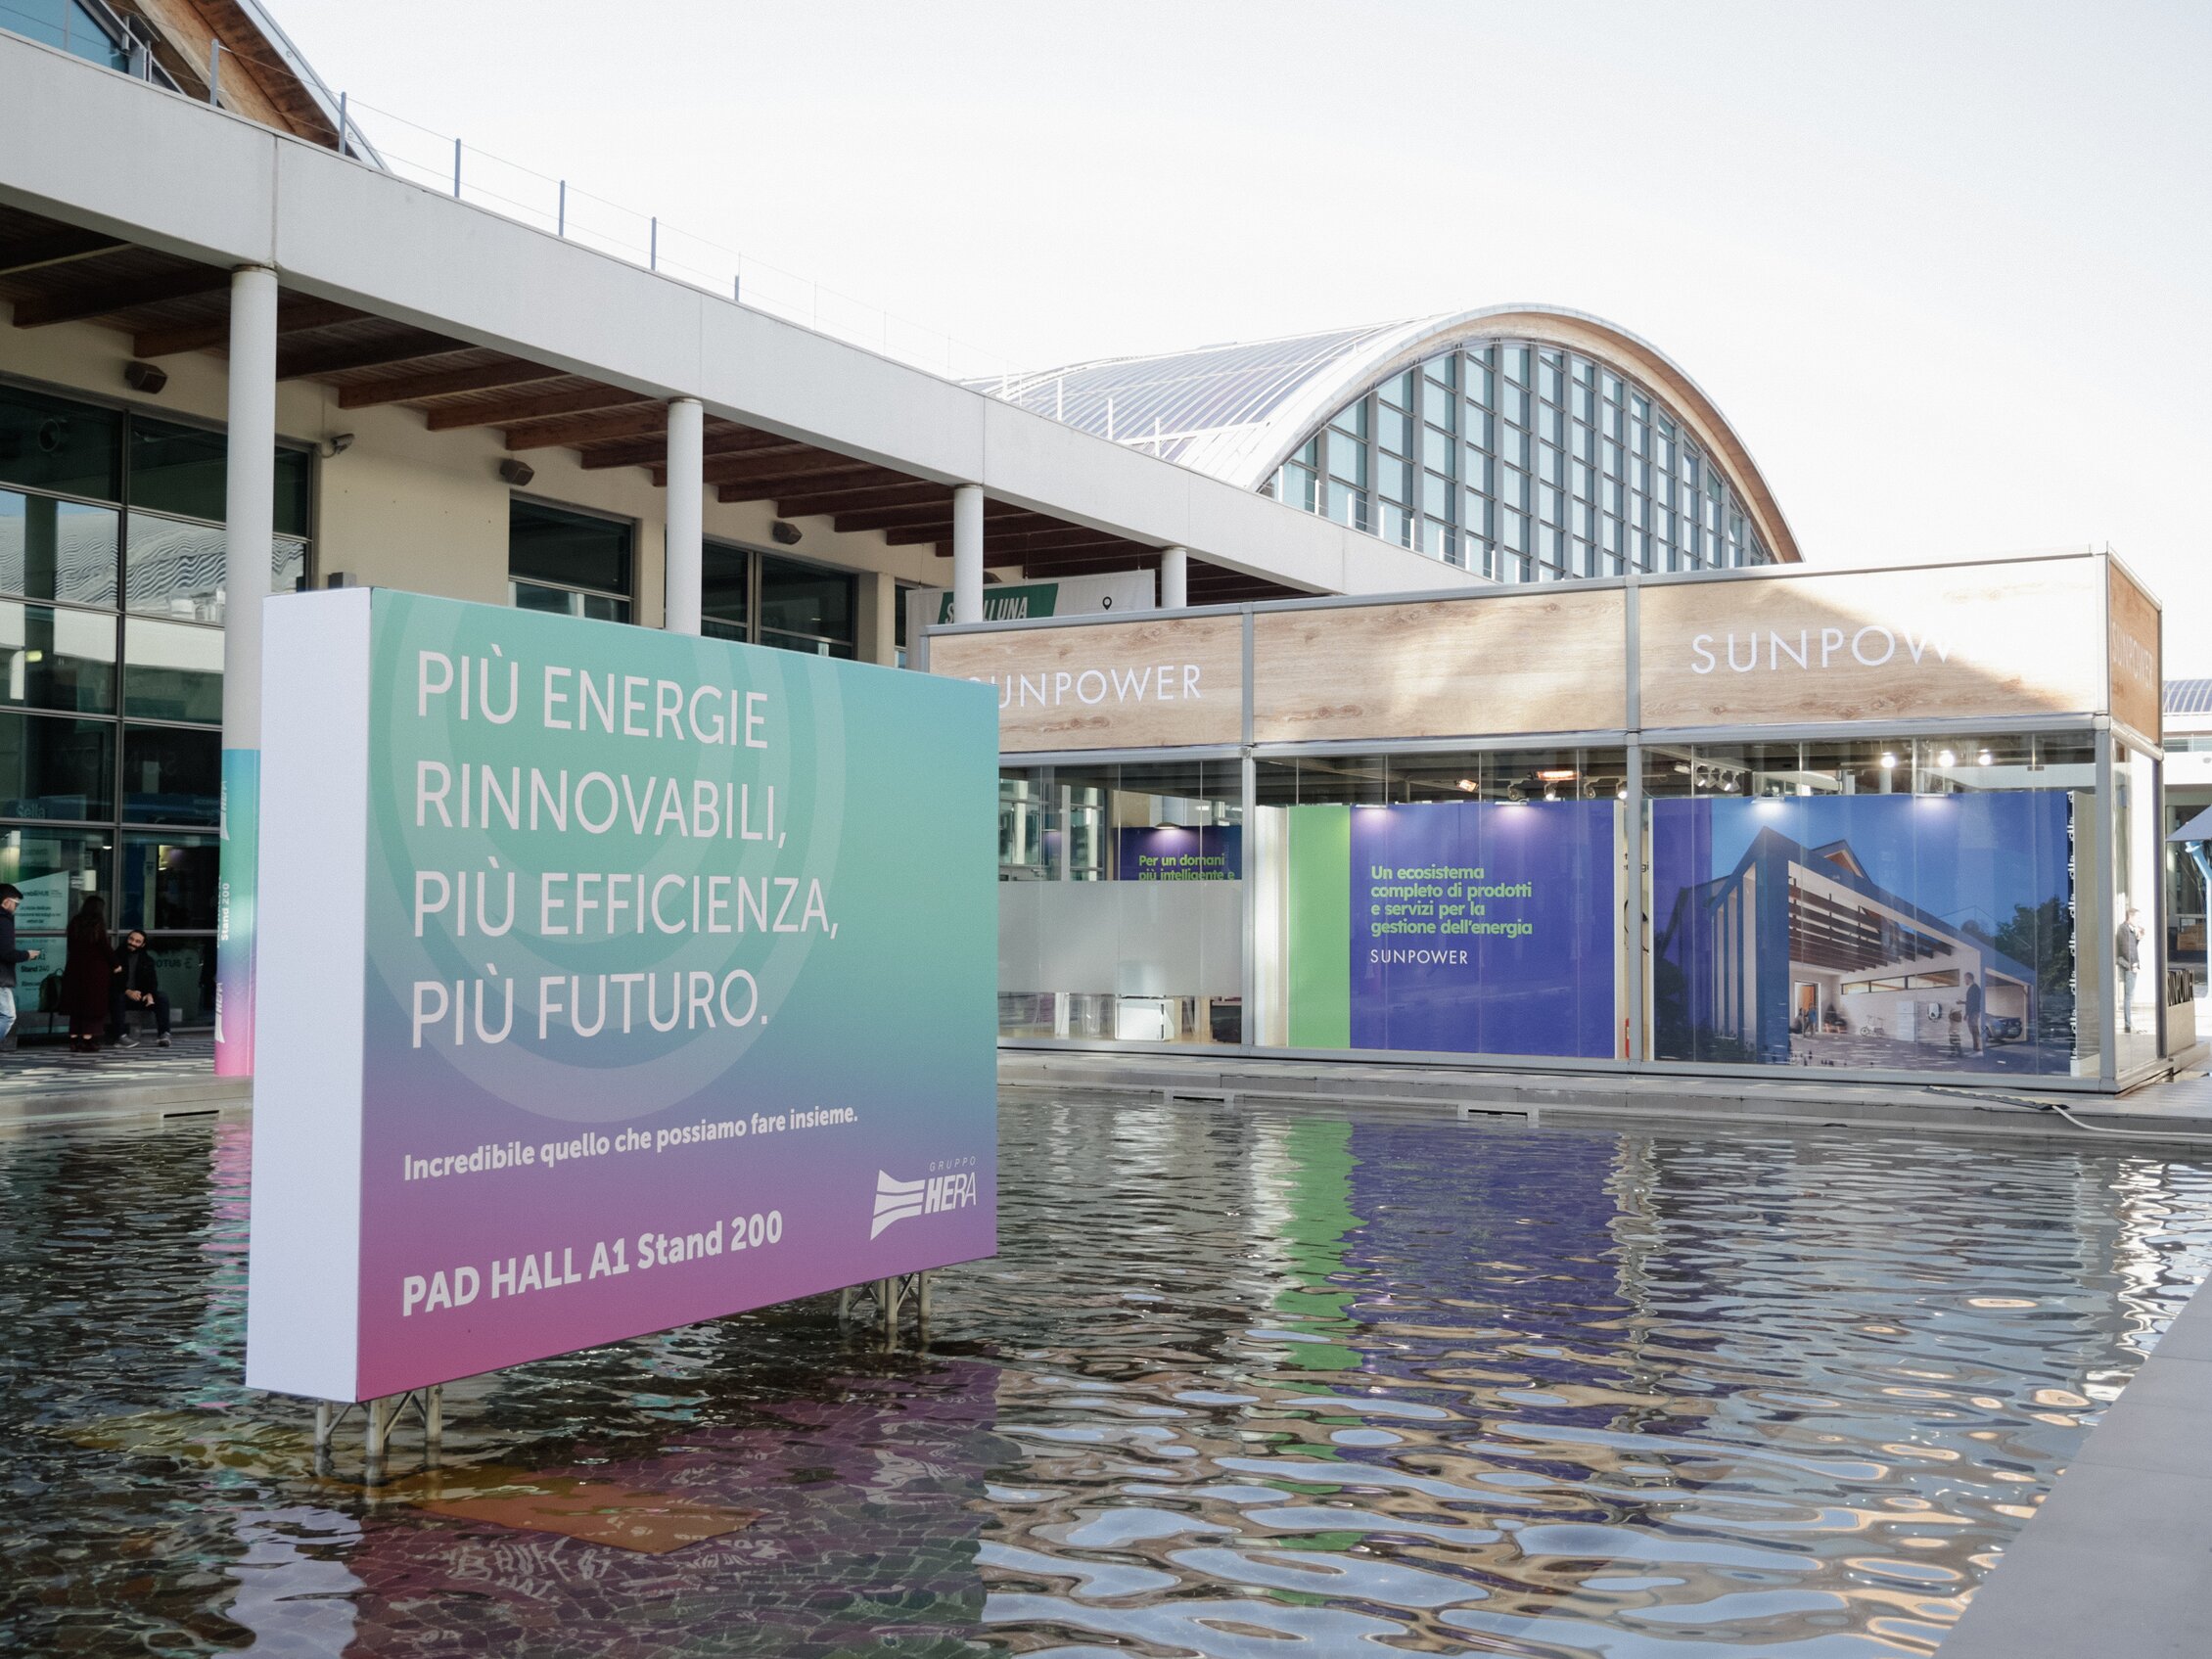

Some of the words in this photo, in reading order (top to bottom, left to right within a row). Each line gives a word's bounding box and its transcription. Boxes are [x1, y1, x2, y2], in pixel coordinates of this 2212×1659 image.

[996, 597, 1028, 621] UNA
[418, 643, 519, 725] PIÙ
[543, 665, 768, 749] ENERGIE
[969, 665, 1202, 709] UNPOWER
[416, 760, 786, 849] RINNOVABILI,
[1138, 854, 1159, 866] Per
[1161, 856, 1176, 866] un
[1179, 853, 1225, 866] domani
[1371, 865, 1393, 880] Un
[1397, 863, 1484, 880] ecosistema
[221, 883, 231, 904] 200
[415, 855, 515, 938] PIÙ
[540, 871, 838, 940] EFFICIENZA,
[1370, 883, 1443, 901] completo
[1447, 882, 1462, 898] di
[1467, 882, 1532, 901] prodotti
[1370, 904, 1381, 915] e
[1385, 899, 1434, 916] servizi
[1439, 903, 1466, 919] per
[1470, 900, 1486, 916] la
[221, 907, 230, 941] Stand
[1370, 918, 1436, 938] gestione
[1440, 918, 1533, 939] dell'energia
[1370, 949, 1468, 964] SUNPOWER
[413, 963, 513, 1048] PIÙ
[538, 968, 768, 1040] FUTURO.
[403, 1141, 535, 1181] Incredibile
[540, 1130, 611, 1168] quello
[615, 1127, 652, 1154] che
[656, 1118, 747, 1153] possiamo
[751, 1112, 786, 1135] fare
[790, 1104, 859, 1131] insieme.
[929, 1155, 977, 1173] GRUPPO
[924, 1172, 977, 1215] HERA
[402, 1266, 480, 1317] PAD
[490, 1248, 581, 1299] HALL
[588, 1238, 629, 1279] A1
[637, 1220, 723, 1269] Stand
[730, 1210, 783, 1252] 200
